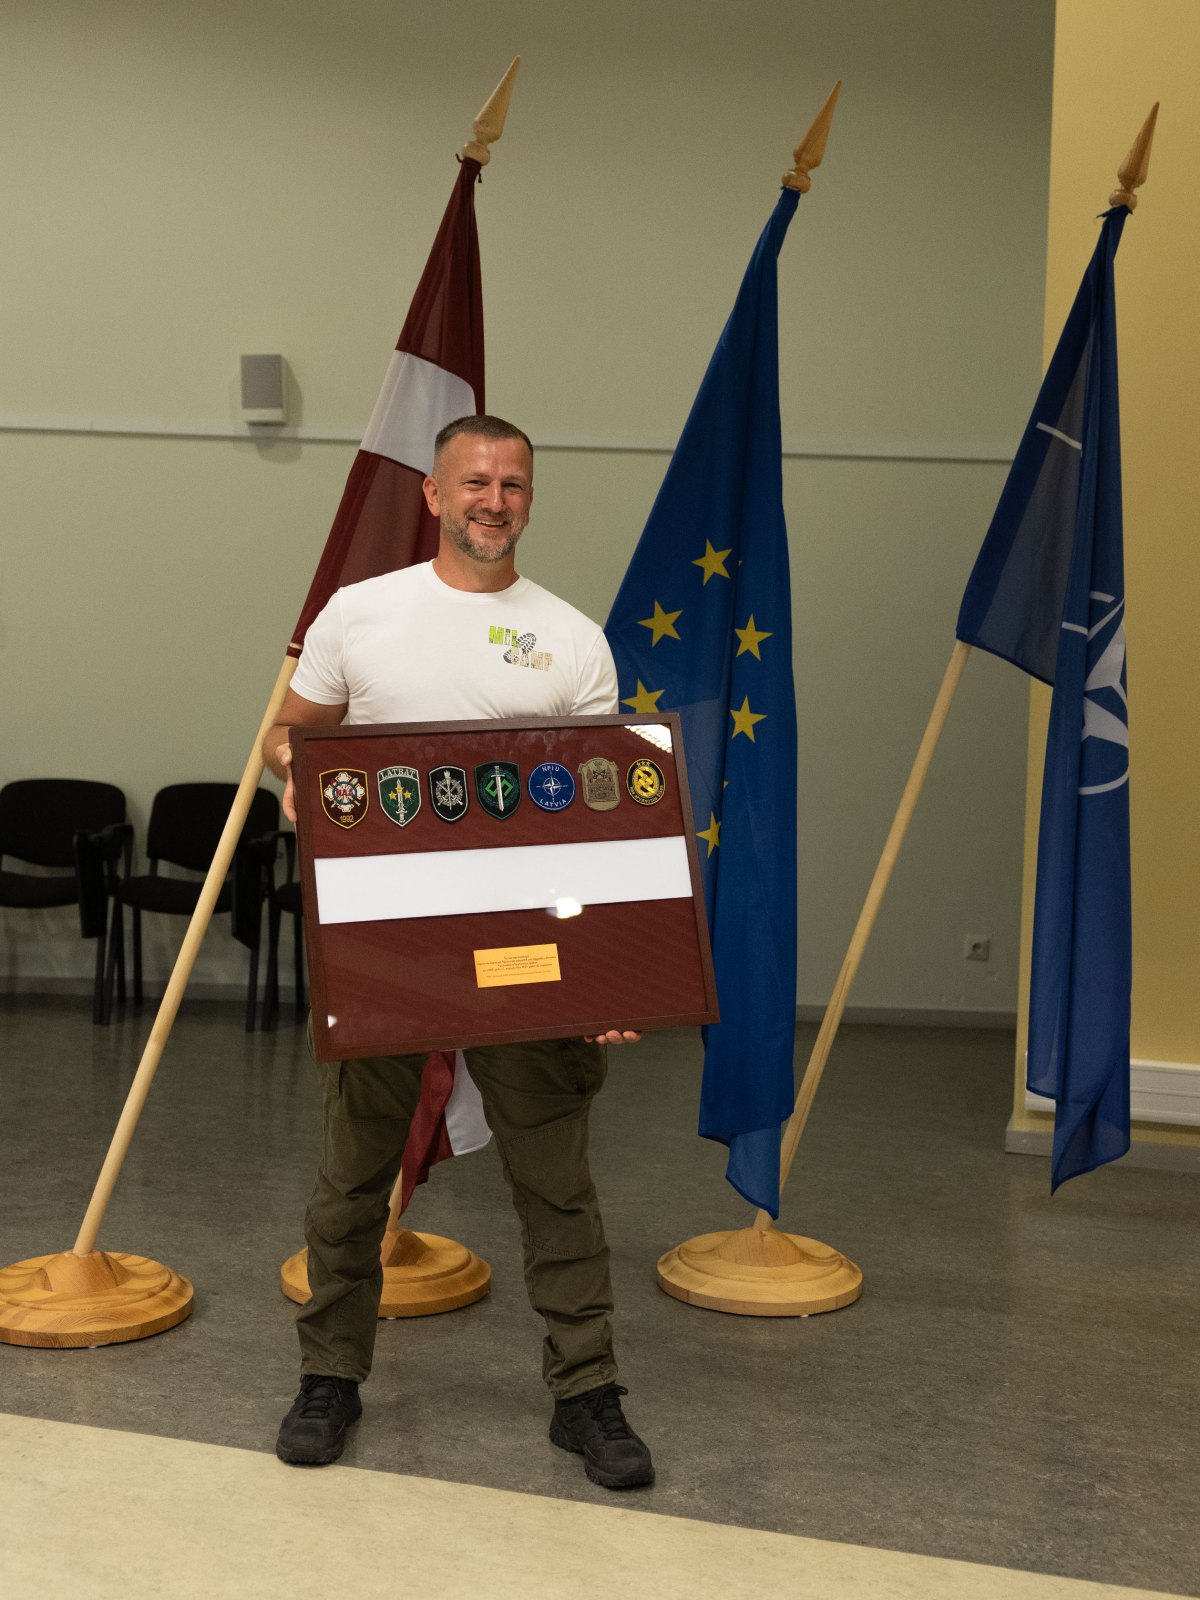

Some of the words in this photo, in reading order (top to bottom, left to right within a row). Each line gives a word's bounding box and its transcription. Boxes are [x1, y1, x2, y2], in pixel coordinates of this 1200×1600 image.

[380, 767, 416, 780] LATBAT
[539, 798, 567, 808] LATVIA
[340, 814, 355, 824] 1992
